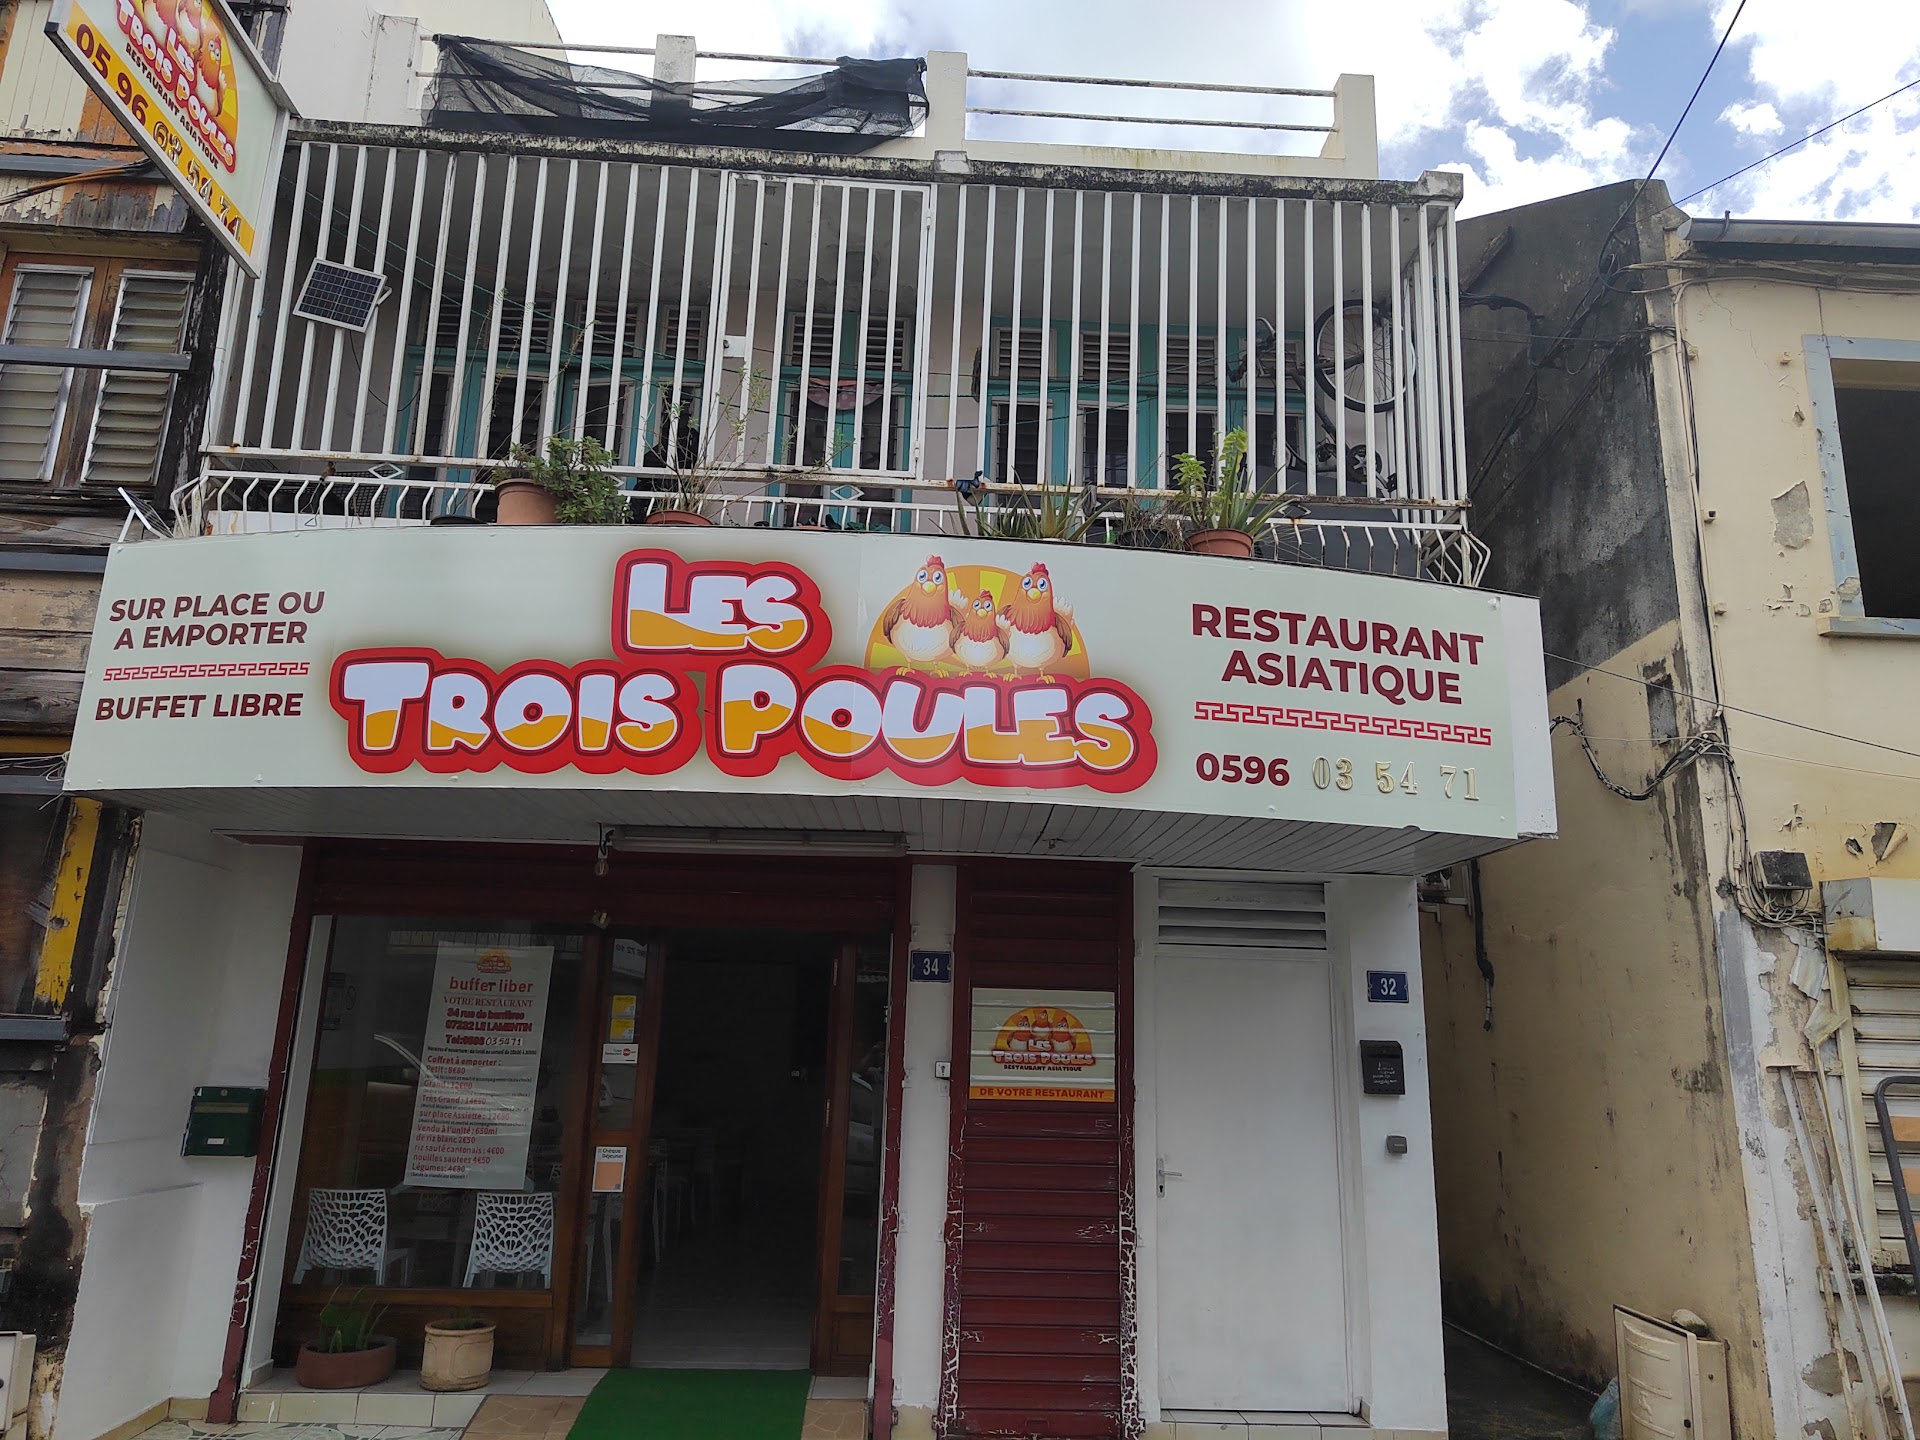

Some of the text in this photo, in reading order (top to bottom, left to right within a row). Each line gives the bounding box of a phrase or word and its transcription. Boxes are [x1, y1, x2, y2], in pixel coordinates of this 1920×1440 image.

[166, 27, 196, 83] LES
[76, 23, 111, 80] 05
[115, 72, 149, 127] 96
[117, 0, 235, 168] TROIS POULES
[125, 42, 219, 170] RESTAURANT ASIATIQUE
[109, 590, 326, 622] SUR PLACE OU
[622, 558, 814, 657] LES
[113, 621, 309, 651] A EMPORTER
[1191, 603, 1485, 666] RESTAURANT
[1221, 650, 1463, 706] ASIATIQUE
[95, 692, 305, 721] BUFFET LIBRE
[338, 657, 1137, 773] TROIS POULES
[1195, 752, 1481, 802] 0596 03 54 71
[922, 958, 939, 976] 34
[499, 979, 534, 993] liber
[1380, 978, 1397, 996] 32
[444, 997, 533, 1008] VOTRE RESTAURANT
[1028, 1039, 1052, 1052] LES
[428, 1056, 454, 1064] Coffret
[456, 1056, 460, 1064] à
[460, 1058, 498, 1066] emporter
[992, 1050, 1094, 1065] TROIS POULES
[426, 1065, 443, 1074] Petit
[980, 1088, 1105, 1099] DE VOTRE RESTAURANT
[432, 1110, 452, 1119] place
[453, 1112, 482, 1120] Assiette
[418, 1124, 440, 1132] Vendu
[447, 1126, 471, 1134] l'unité
[476, 1127, 498, 1135] 650ml
[437, 1134, 457, 1143] blanc
[414, 1154, 443, 1162] nouilles
[425, 1144, 446, 1152] sauté
[446, 1146, 482, 1154] cantonais
